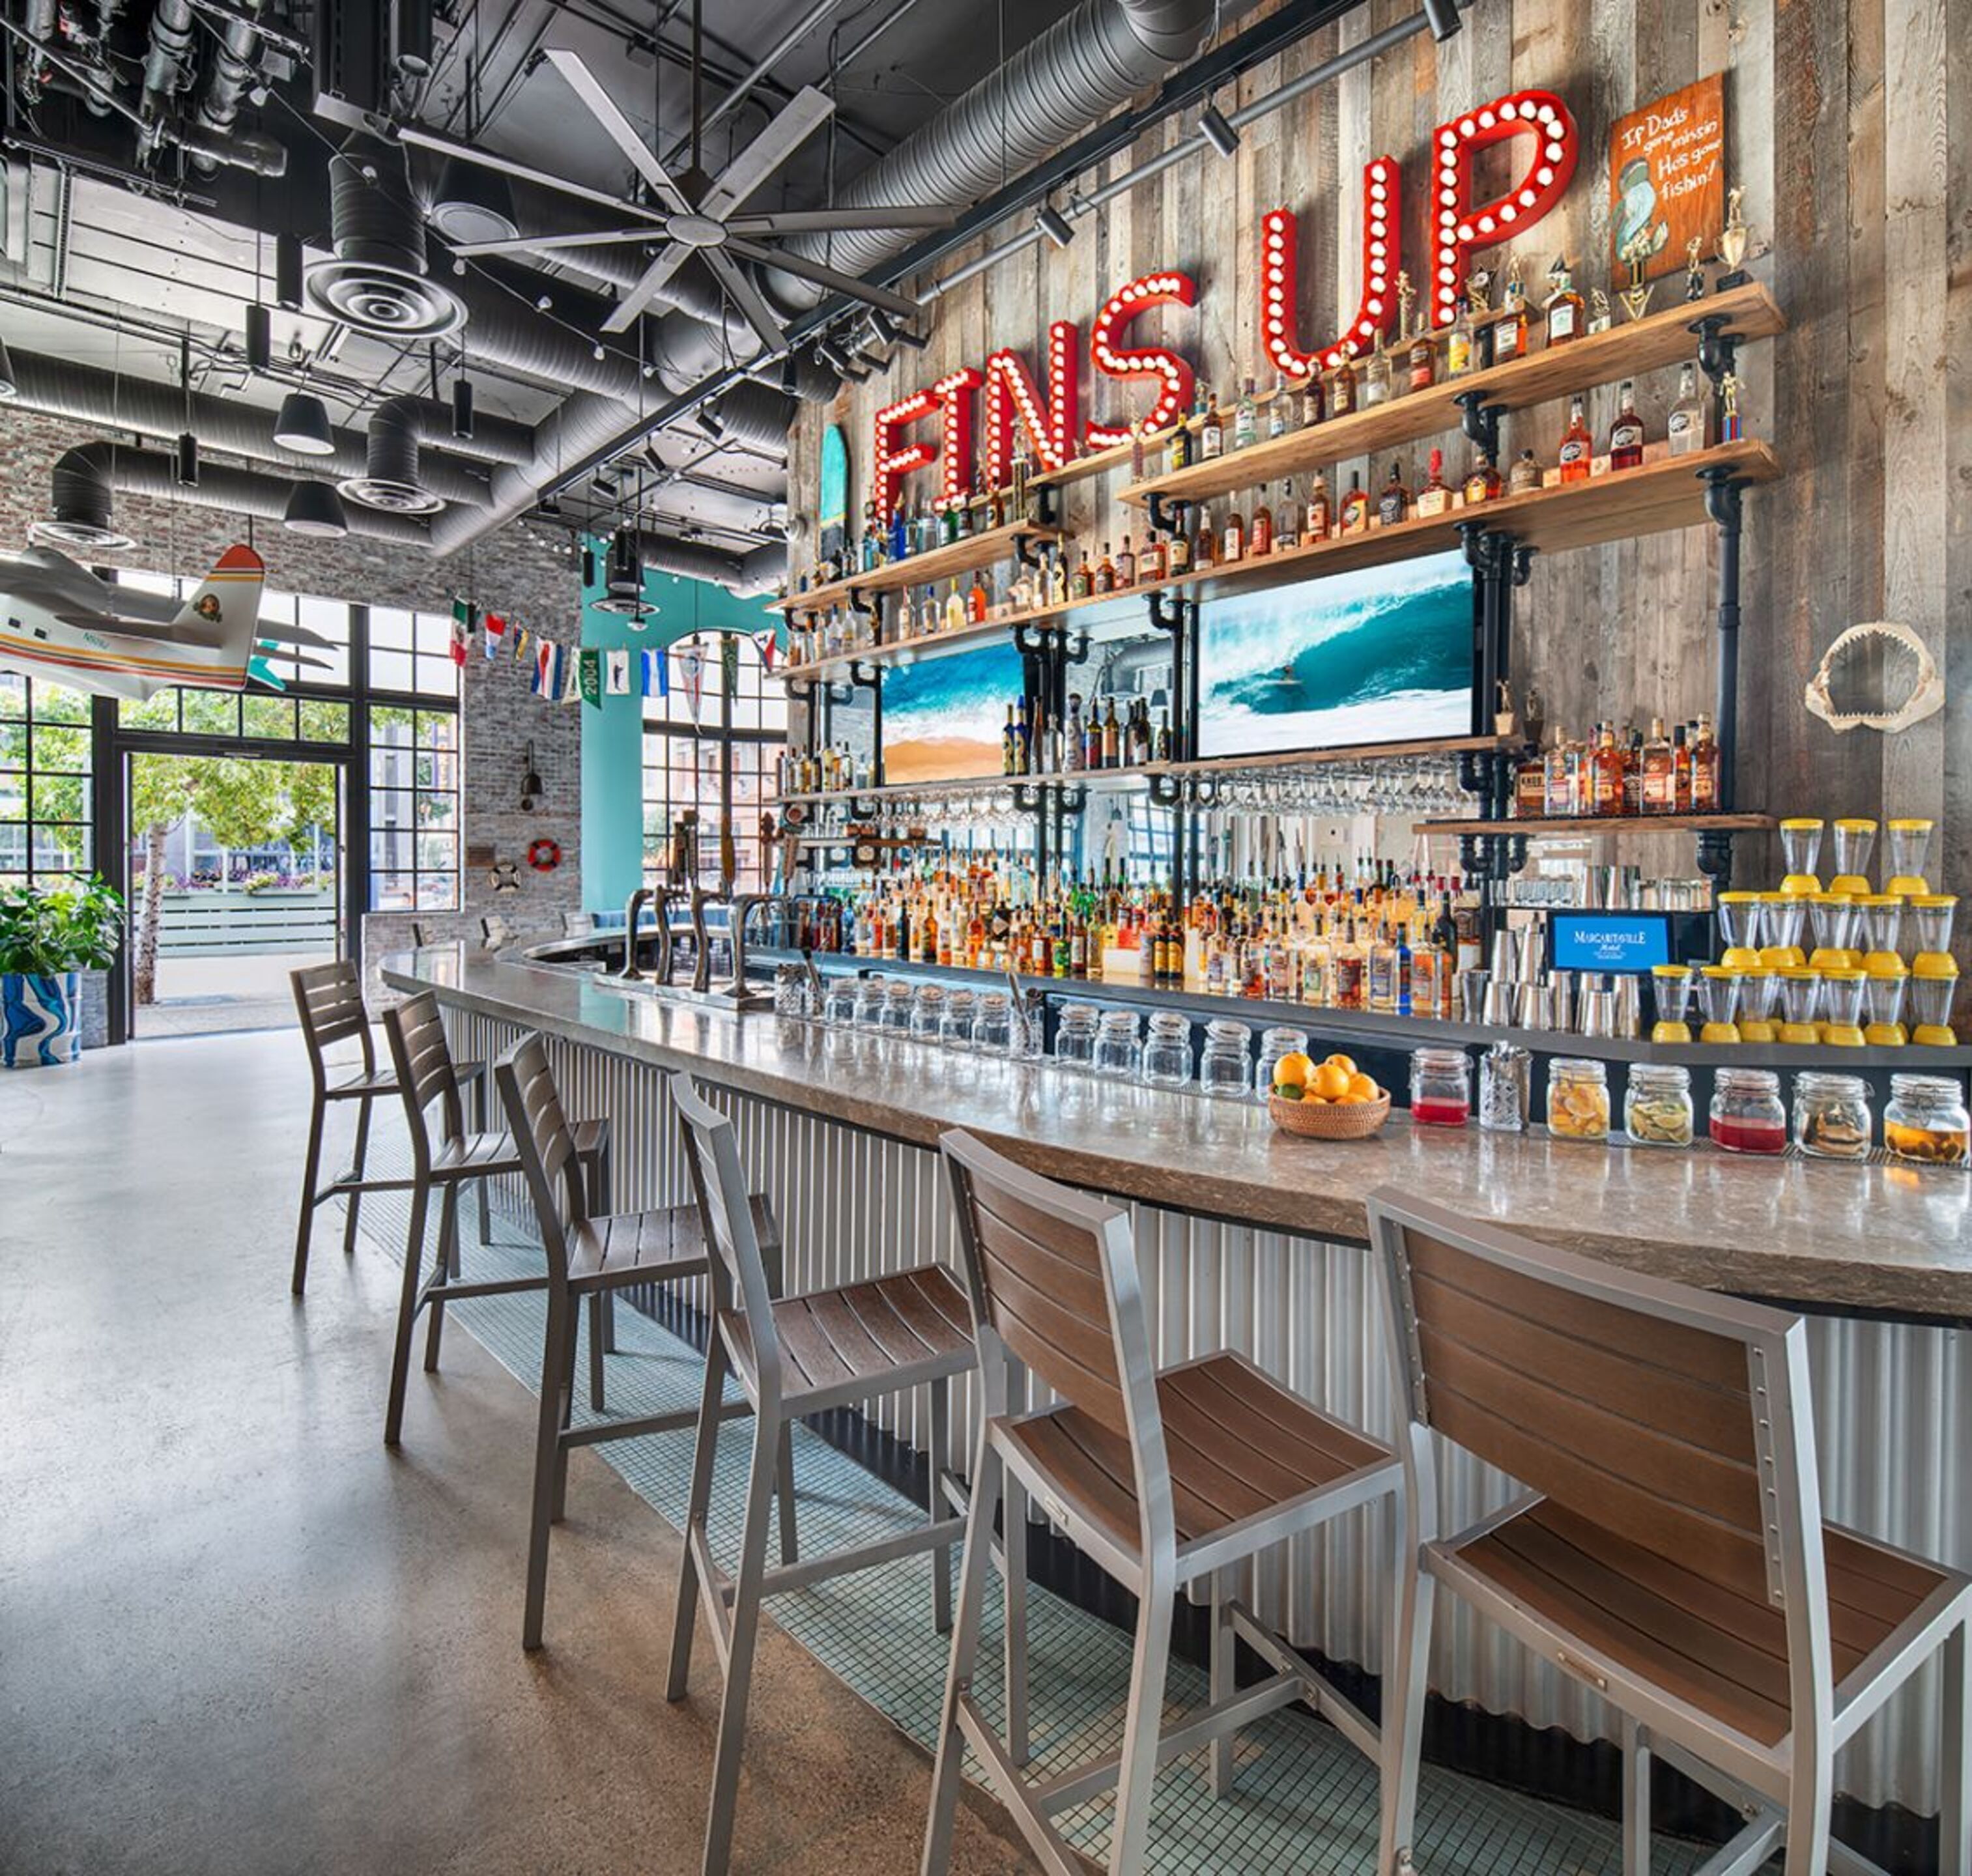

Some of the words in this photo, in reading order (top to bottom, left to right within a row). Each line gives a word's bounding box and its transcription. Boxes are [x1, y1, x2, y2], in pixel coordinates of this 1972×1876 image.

[1621, 126, 1645, 150] If
[1643, 130, 1674, 156] gone
[1692, 139, 1722, 165] gone
[874, 269, 1199, 524] FINS
[1261, 87, 1579, 379] UP
[583, 659, 598, 696] 2004
